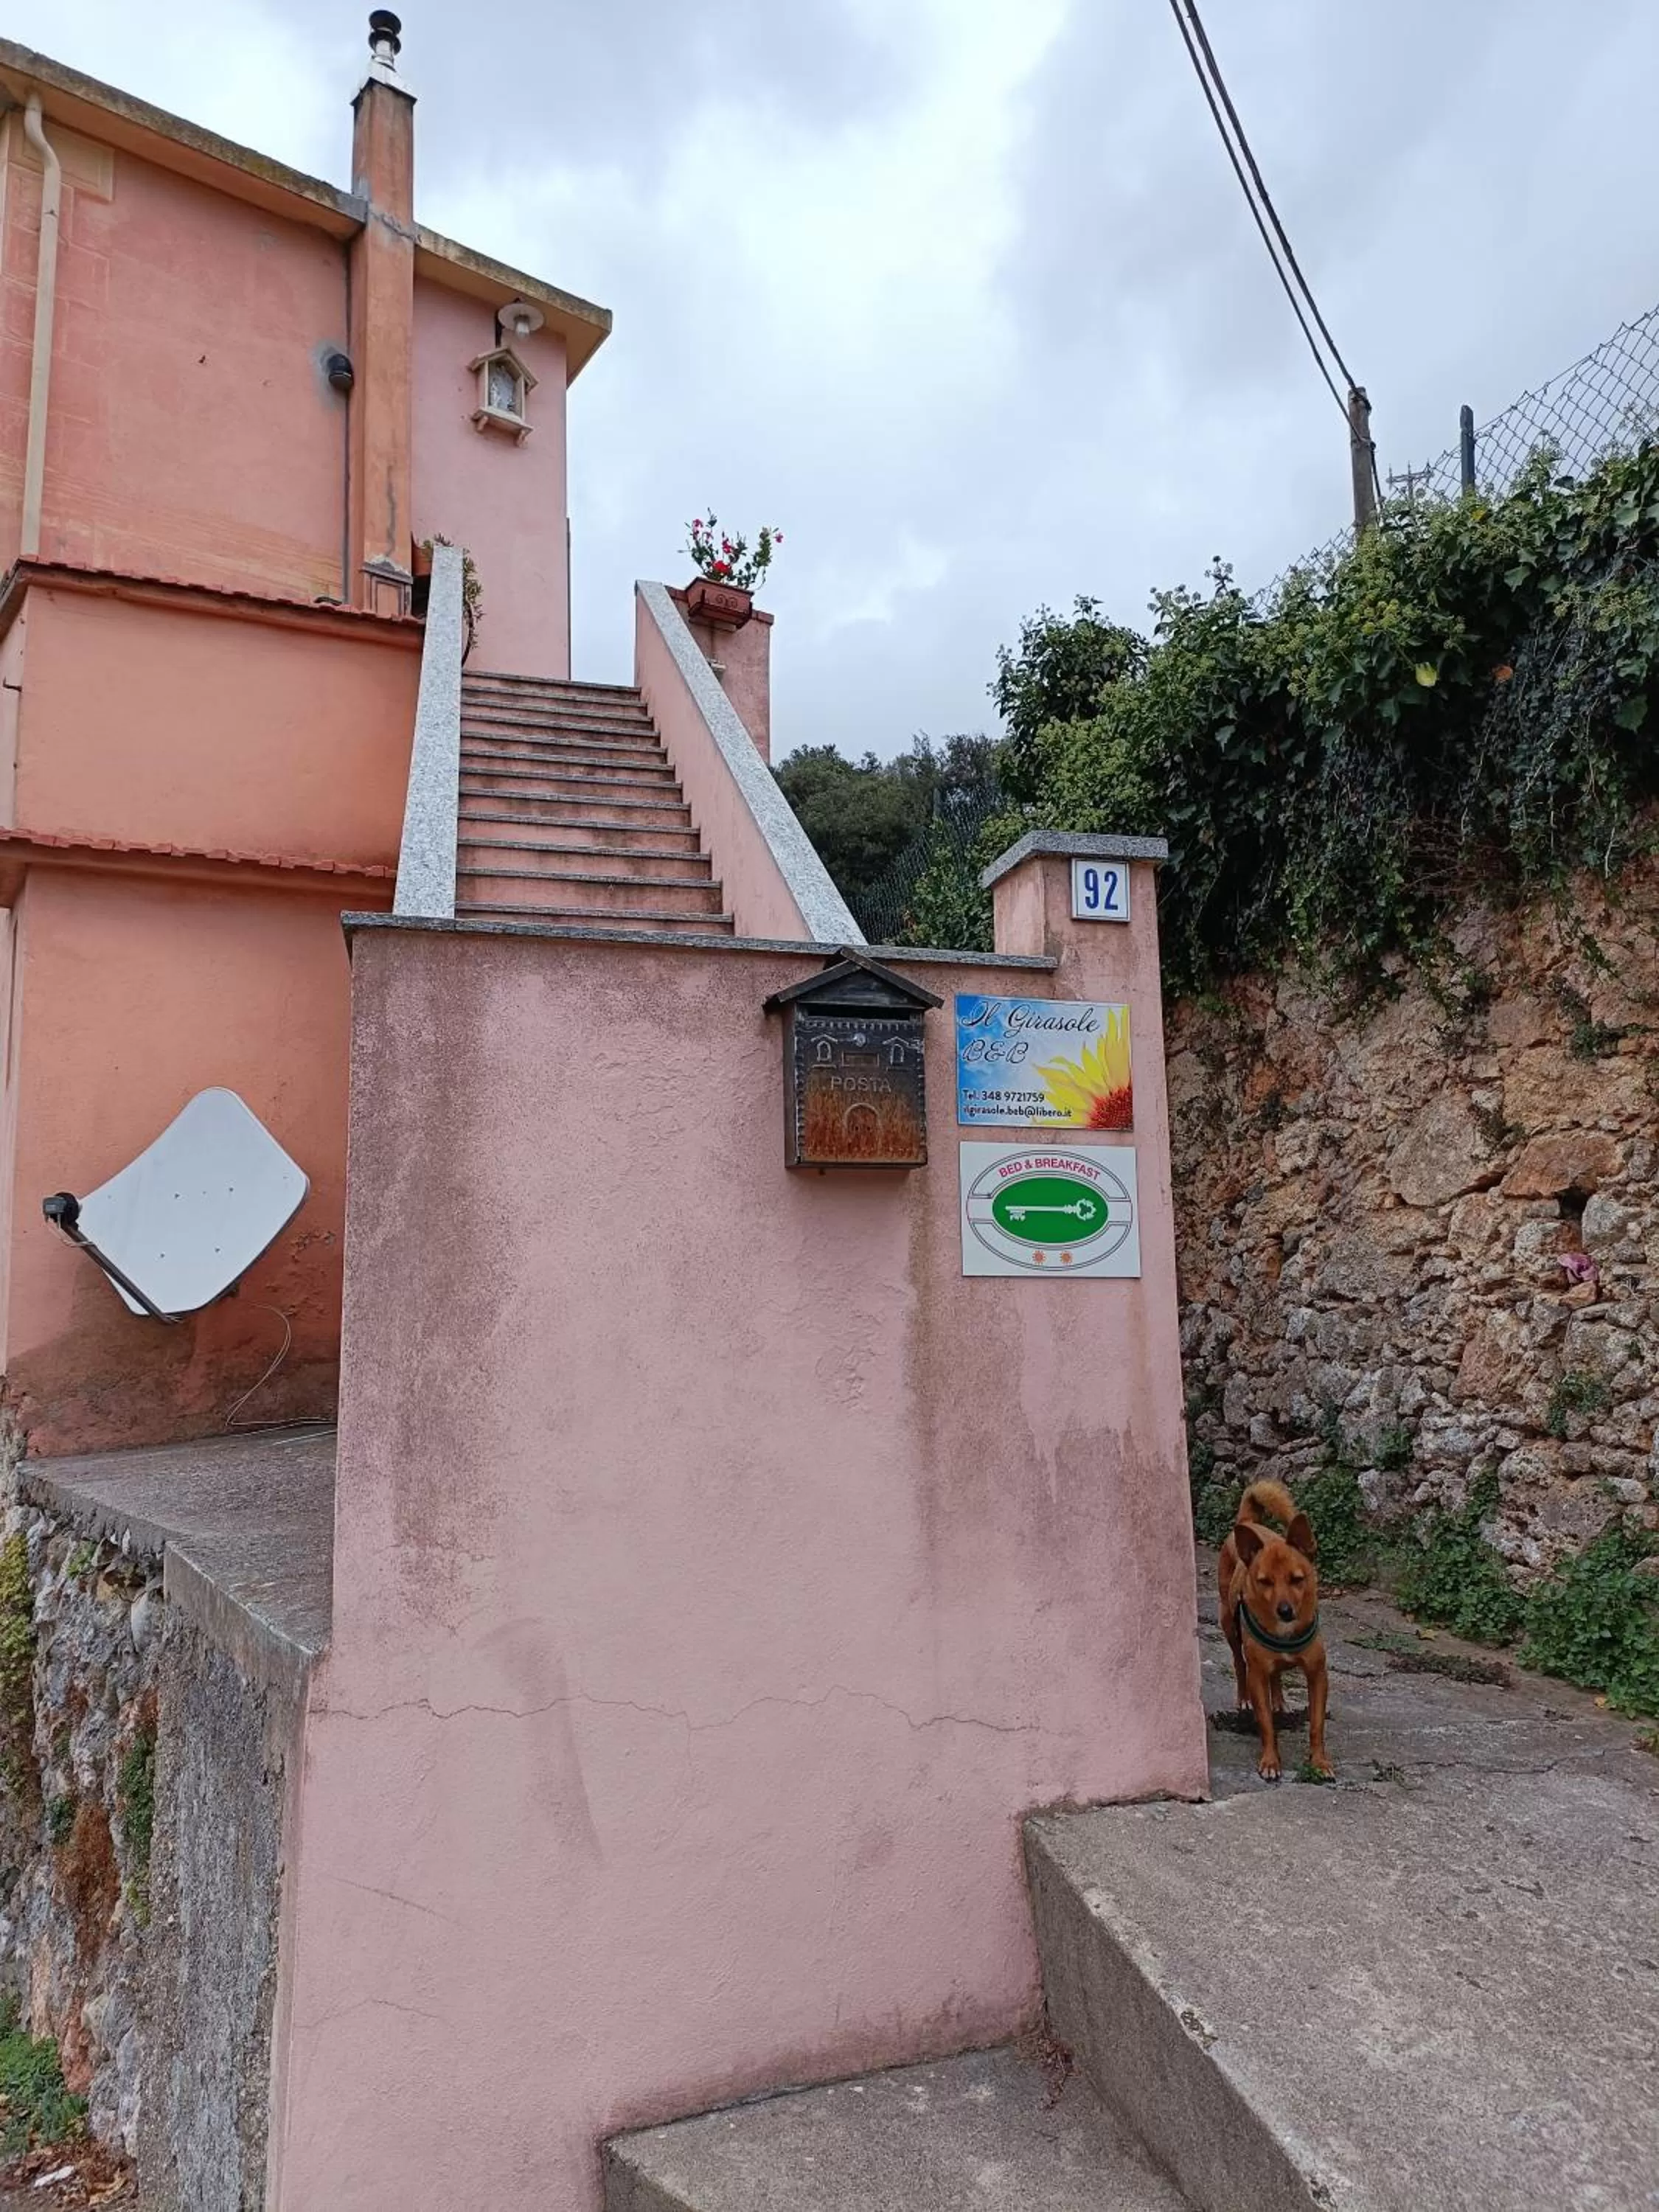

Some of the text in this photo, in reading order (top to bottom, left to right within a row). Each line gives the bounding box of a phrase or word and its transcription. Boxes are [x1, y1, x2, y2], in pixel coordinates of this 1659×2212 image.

[1085, 868, 1119, 910] 92
[961, 1001, 1100, 1038] Il Girasole
[962, 1039, 1029, 1064] B&B
[830, 1076, 891, 1093] POSTA
[981, 1091, 1001, 1101] 348
[1004, 1091, 1045, 1102] 9721759
[998, 1158, 1101, 1180] BED & BREAKFAST
